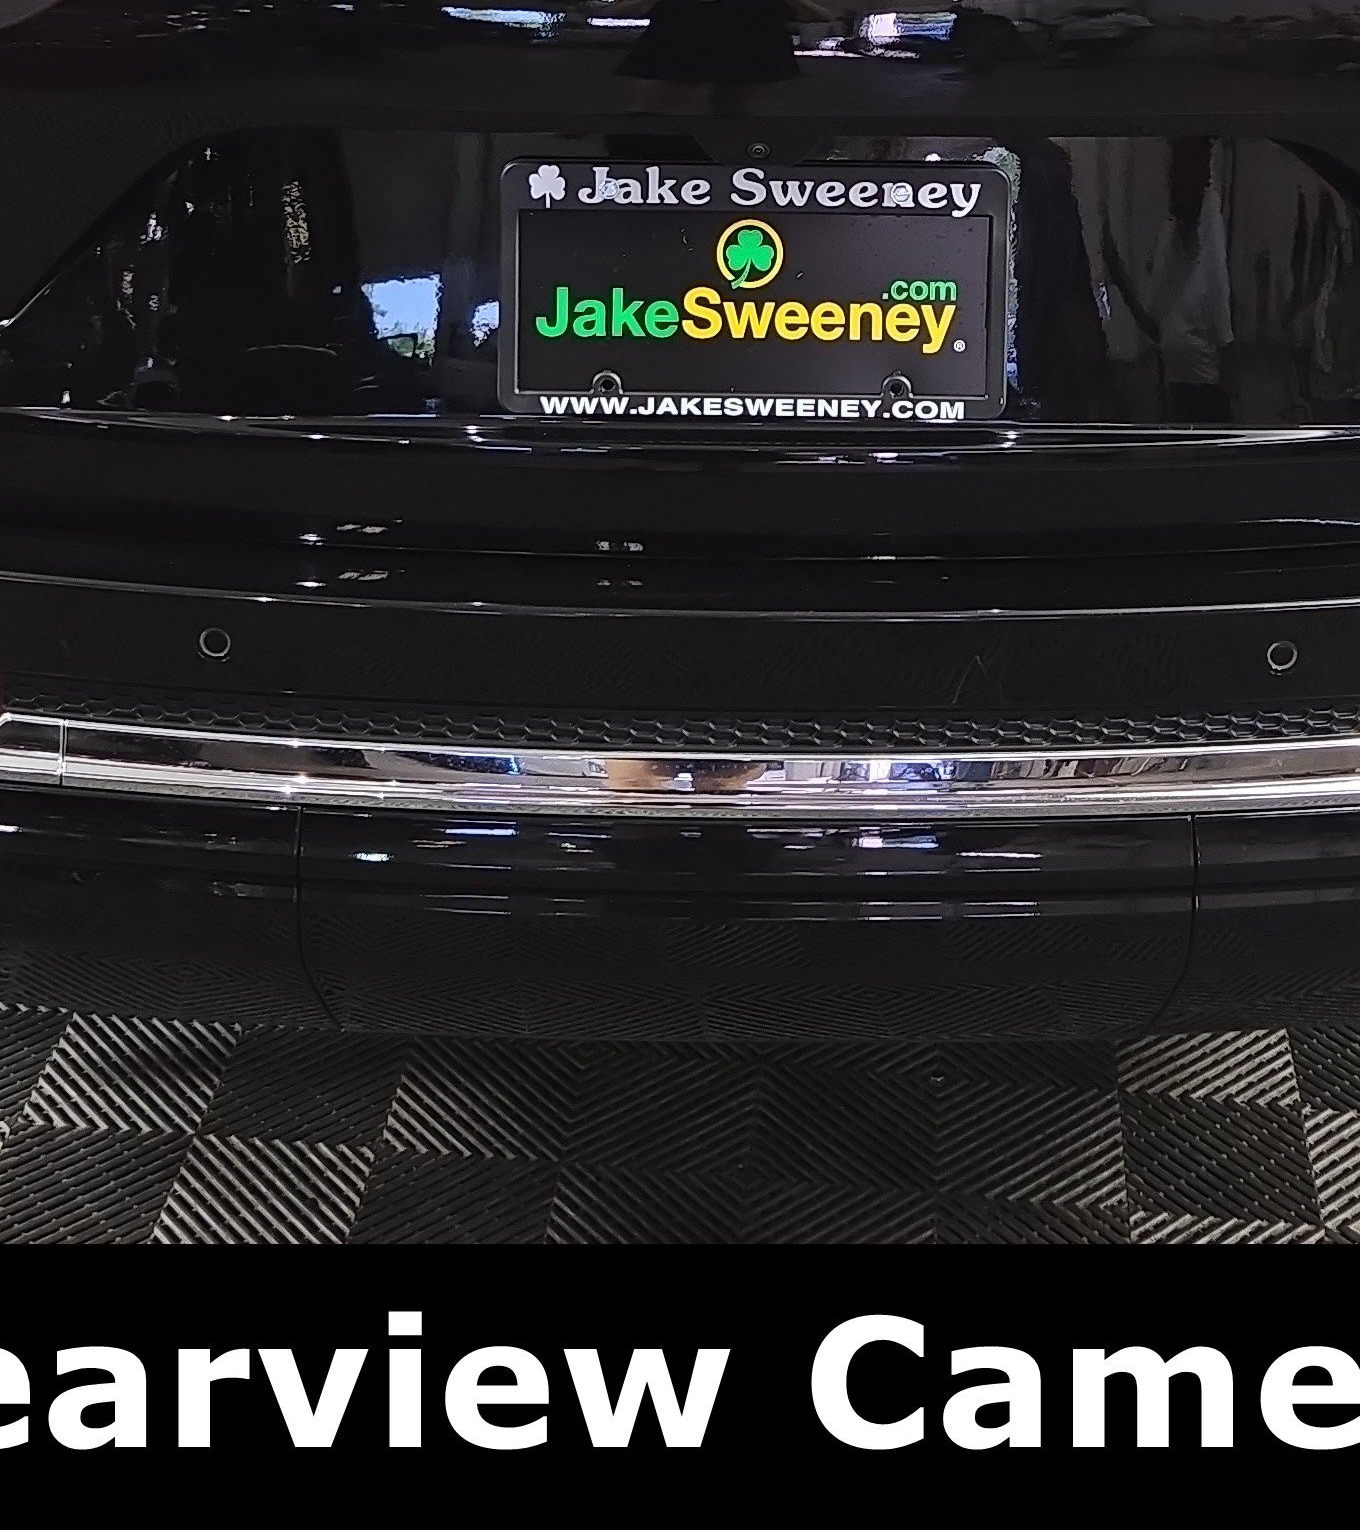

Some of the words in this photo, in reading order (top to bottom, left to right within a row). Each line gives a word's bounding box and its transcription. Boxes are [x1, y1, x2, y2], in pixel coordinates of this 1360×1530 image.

[578, 166, 711, 205] Jake
[730, 167, 982, 218] Sweeney
[540, 395, 966, 420] WWW.JAKESWEENEY.COM
